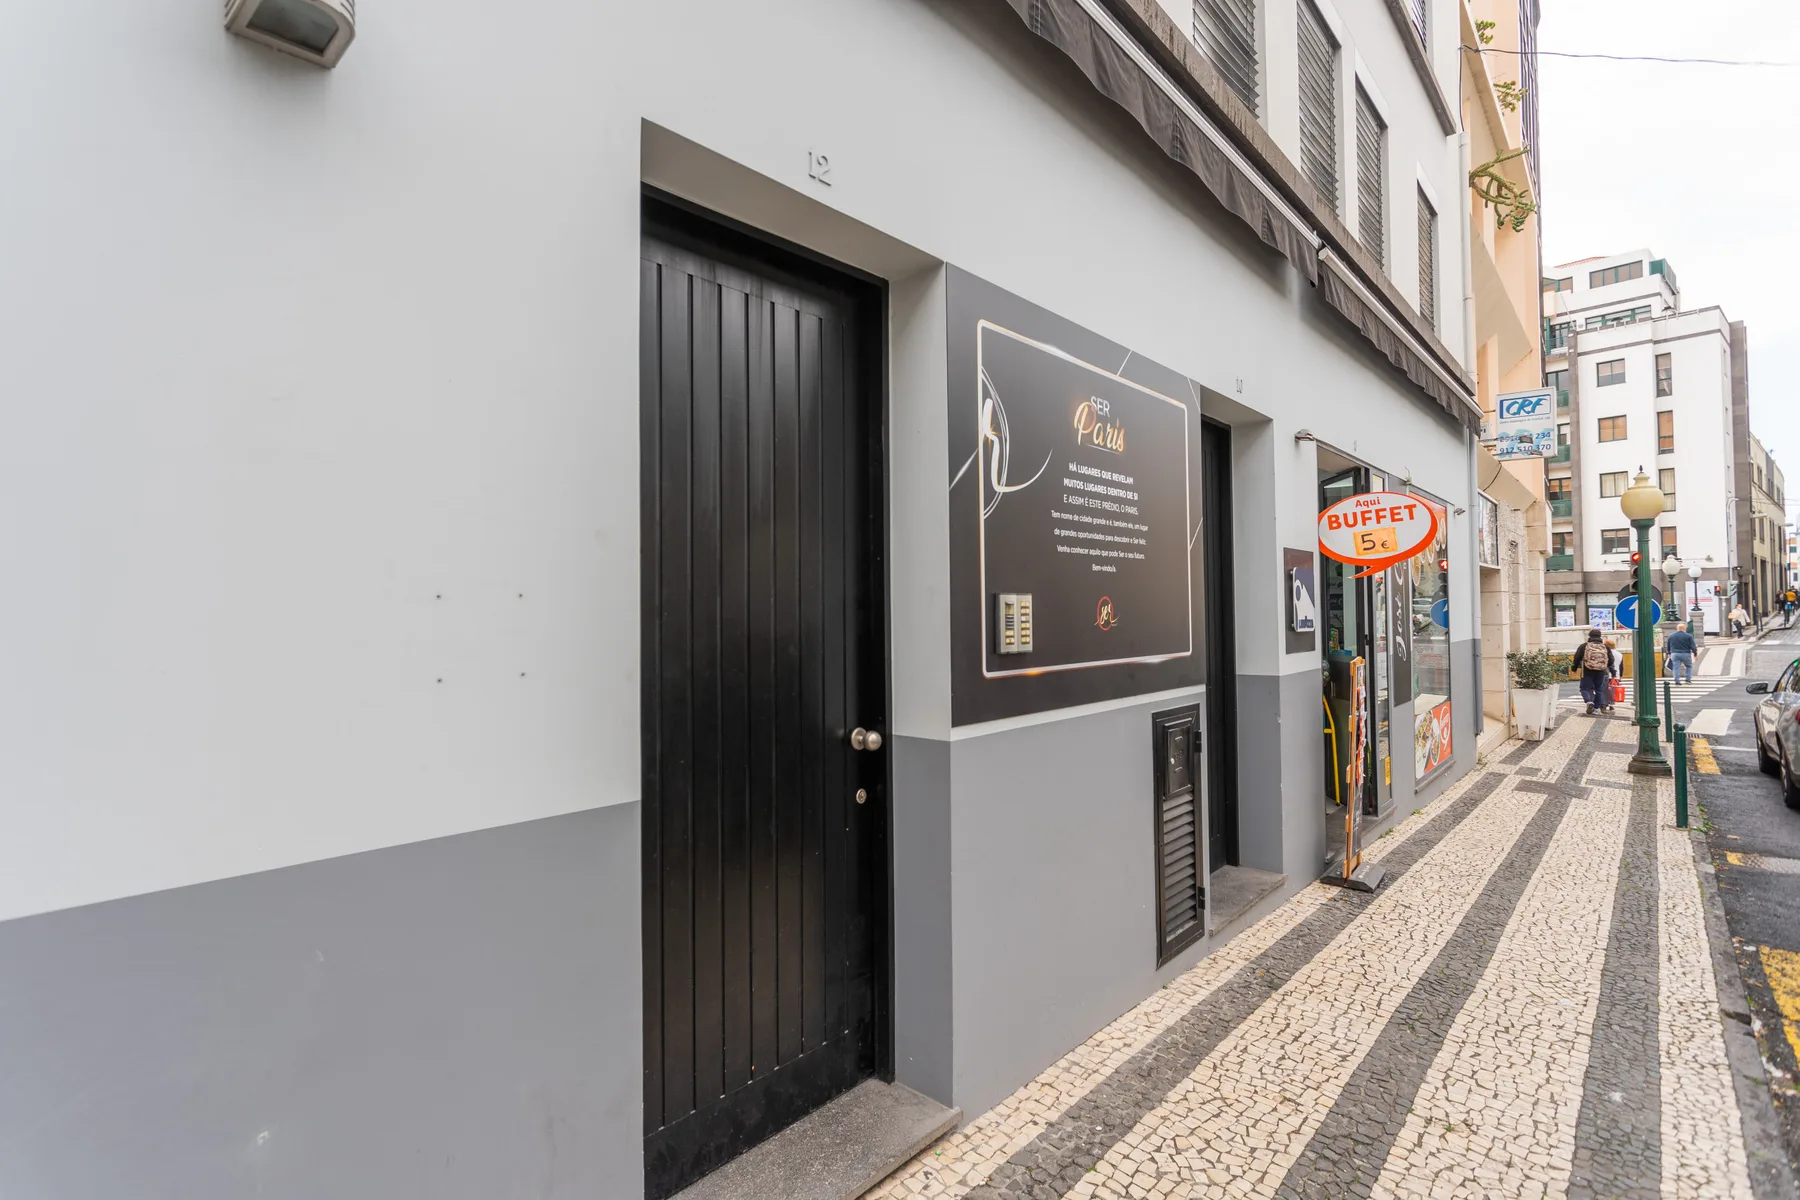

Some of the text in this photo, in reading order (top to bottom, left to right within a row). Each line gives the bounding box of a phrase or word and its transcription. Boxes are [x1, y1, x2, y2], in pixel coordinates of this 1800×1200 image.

[807, 147, 832, 187] 12
[1090, 396, 1110, 417] SER
[1506, 398, 1548, 416] CRF
[1074, 402, 1125, 452] Paris
[1069, 462, 1133, 484] HÁ LUGARES QUE REVELAM
[1064, 478, 1083, 489] MUITOS
[1084, 482, 1107, 494] LUGARES
[1108, 487, 1126, 498] DENTRO
[1127, 491, 1133, 499] DE
[1064, 494, 1067, 503] E
[1068, 495, 1084, 505] ASSIM
[1090, 498, 1101, 508] ESTE
[1102, 501, 1120, 513] PRÉDIO,
[1121, 505, 1124, 513] O
[1356, 496, 1381, 508] Aqui
[1080, 515, 1092, 523] cidade
[1327, 504, 1416, 530] BUFFET
[1061, 529, 1077, 537] grandes
[1078, 531, 1105, 541] oportunidades
[1361, 533, 1376, 551] 5
[1071, 546, 1088, 555] conhecer
